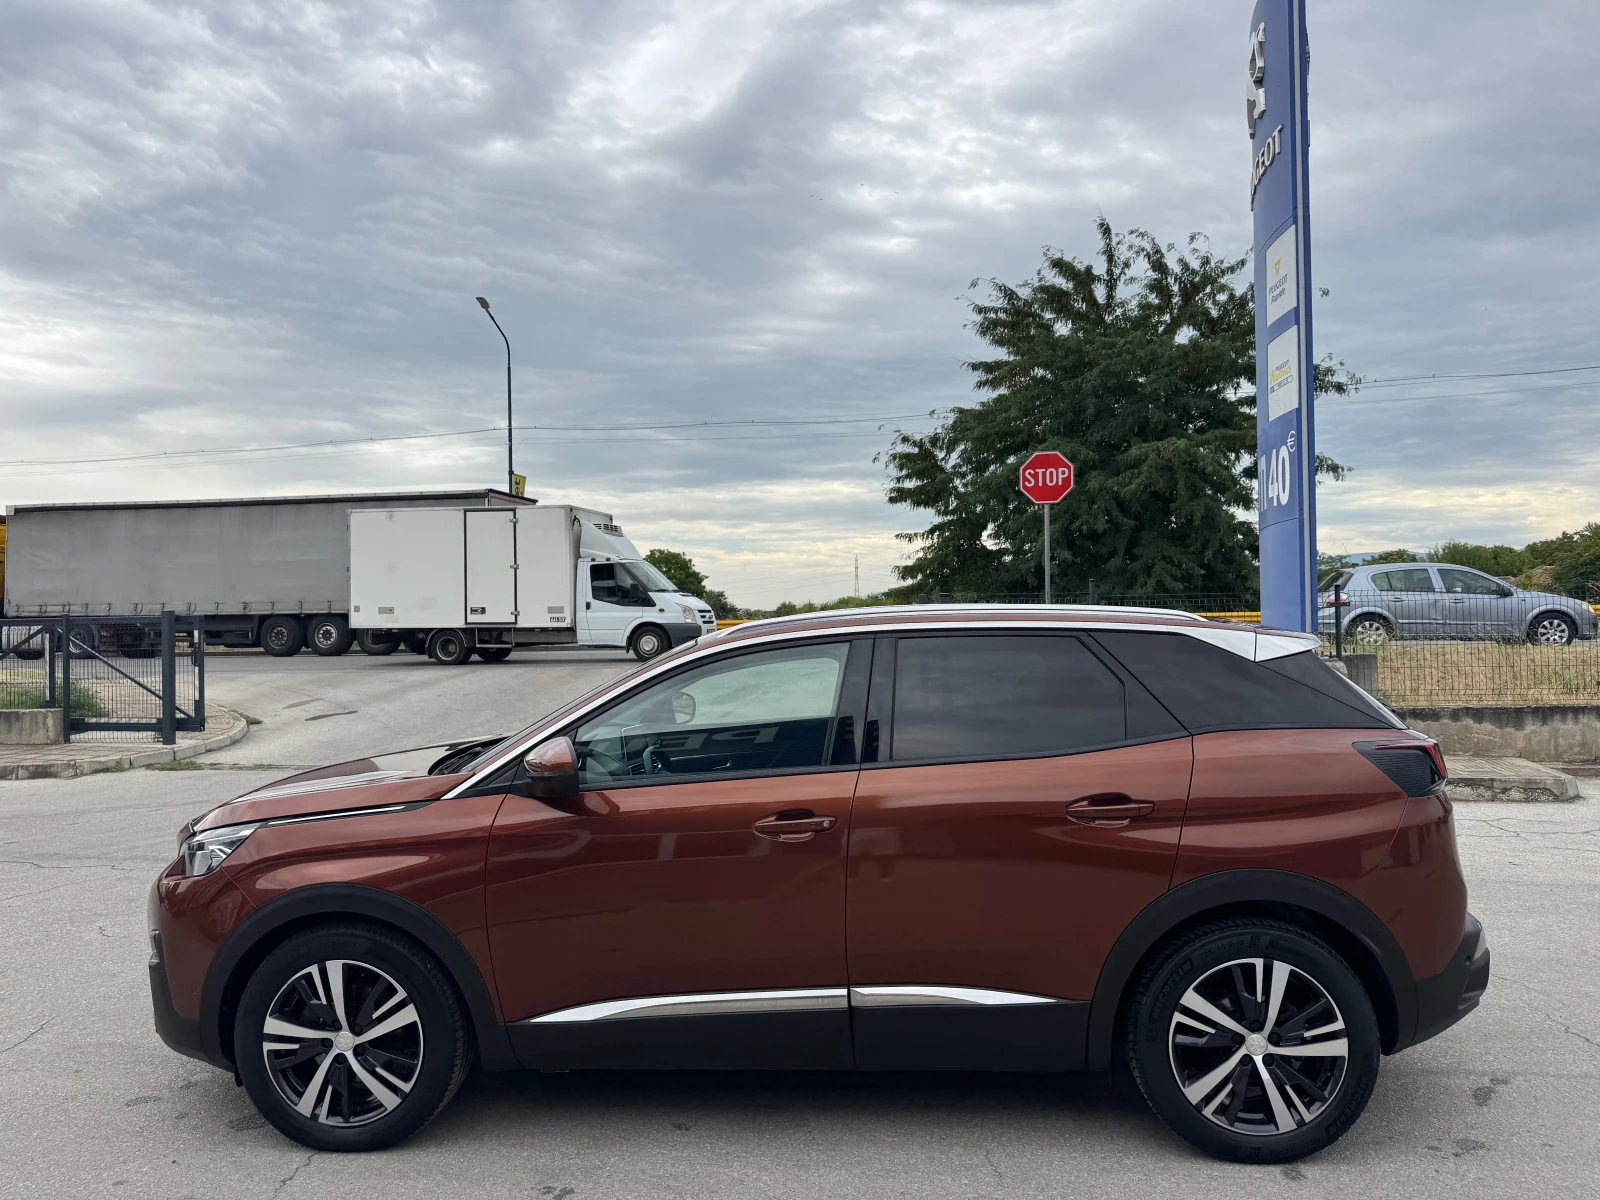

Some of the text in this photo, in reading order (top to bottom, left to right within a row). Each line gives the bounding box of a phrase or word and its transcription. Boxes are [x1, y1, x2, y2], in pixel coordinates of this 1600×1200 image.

[1268, 273, 1288, 296] PEUGEOT
[1024, 467, 1069, 487] STOP
[1151, 959, 1192, 1016] MICHELIN
